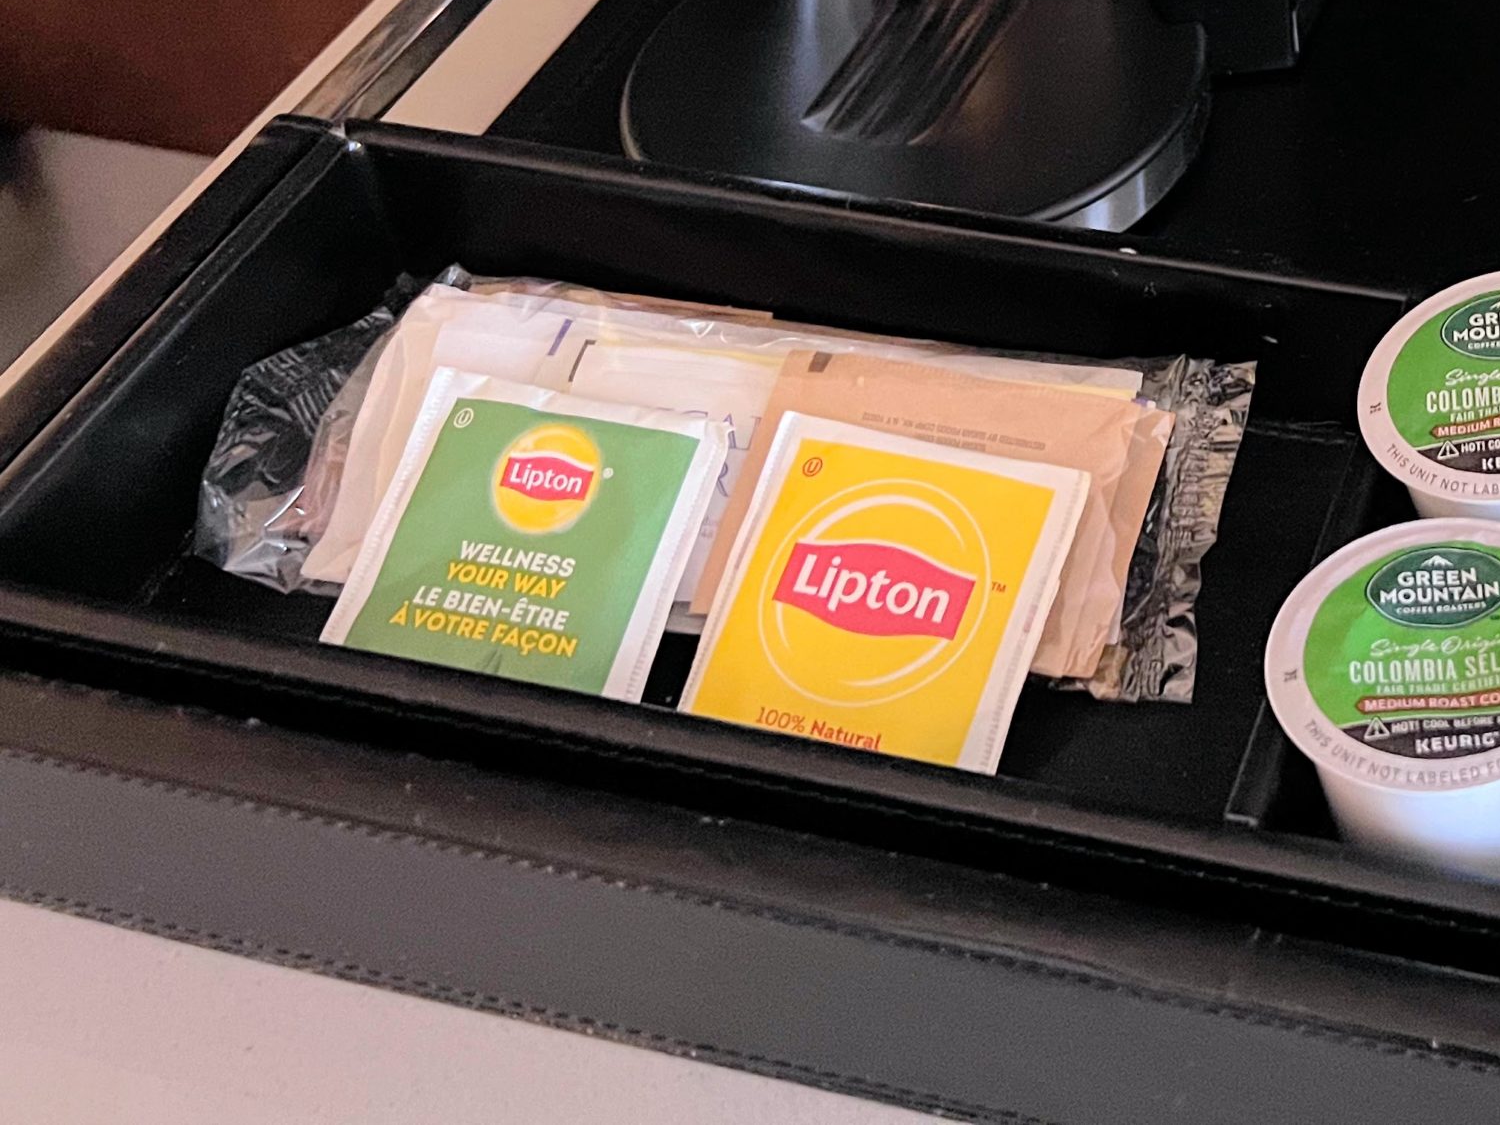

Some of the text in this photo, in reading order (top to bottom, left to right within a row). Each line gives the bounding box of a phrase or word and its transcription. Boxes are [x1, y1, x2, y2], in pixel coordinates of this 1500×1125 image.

[1468, 340, 1500, 350] COFFEE
[1438, 421, 1492, 436] MEDIUM
[1450, 409, 1475, 423] FAIR
[509, 461, 584, 495] Lipton
[1386, 443, 1411, 468] THIS
[1409, 463, 1438, 486] UNIT
[1440, 478, 1468, 494] NOT
[460, 540, 576, 577] WELLNESS
[447, 562, 567, 600] YOUR WAY
[792, 552, 951, 624] Lipton
[1397, 567, 1477, 587] GREEN
[1380, 581, 1500, 605] MOUNTAIN
[412, 584, 570, 632] LE BIEN-ÊTRE
[1396, 601, 1487, 614] COFFEE ROASTERS
[413, 611, 489, 641] VOTRE
[491, 621, 579, 658] FAÇON
[1370, 638, 1439, 657] Single
[1350, 657, 1457, 684] COLOMBIA
[1365, 697, 1426, 712] MEDIUM
[1428, 695, 1478, 709] ROAST
[755, 705, 882, 751] 100% Natural
[1422, 717, 1450, 730] COOL
[1453, 713, 1494, 728] BEFORE
[1304, 719, 1332, 748] THIS
[1331, 745, 1367, 769] UNIT
[1367, 763, 1400, 781] NOT
[1405, 766, 1481, 784] LABELED
[1415, 733, 1496, 754] KEURIG
